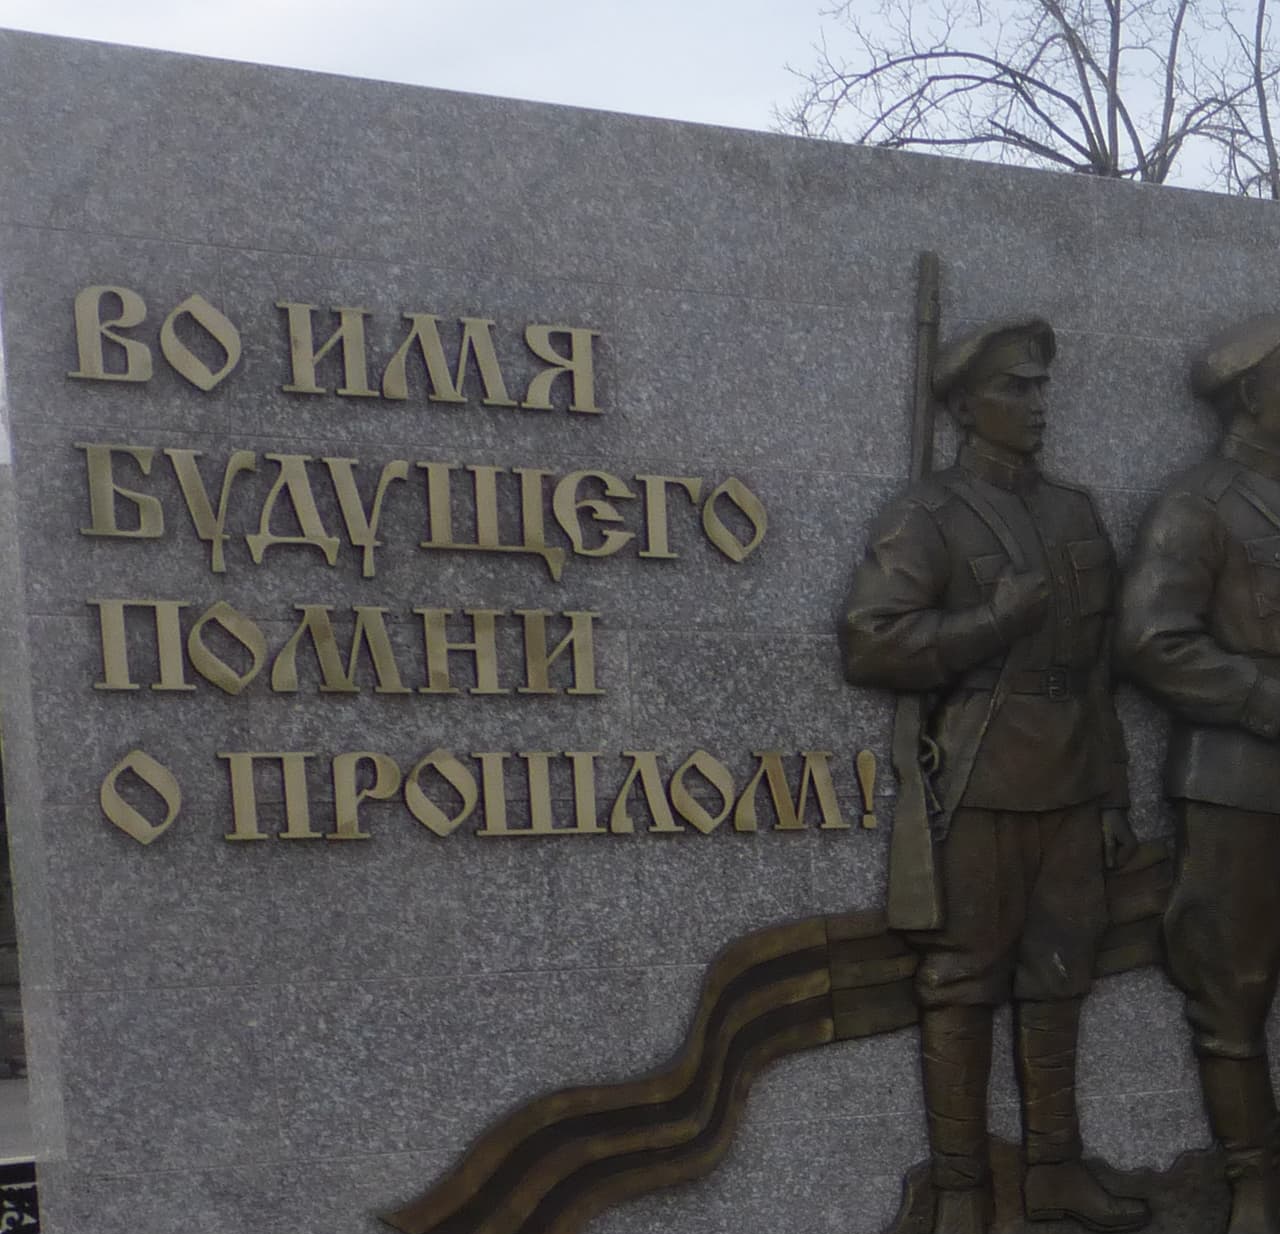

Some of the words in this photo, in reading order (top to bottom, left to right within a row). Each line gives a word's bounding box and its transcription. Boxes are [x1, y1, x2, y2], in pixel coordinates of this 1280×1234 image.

[68, 286, 242, 391] ВО
[276, 301, 602, 413] ИМЯ
[75, 442, 769, 582] БУДУЩЕГО
[86, 601, 605, 696] ПОМНИ
[100, 749, 182, 845] О
[216, 749, 876, 841] ПРОШЛОМ!
